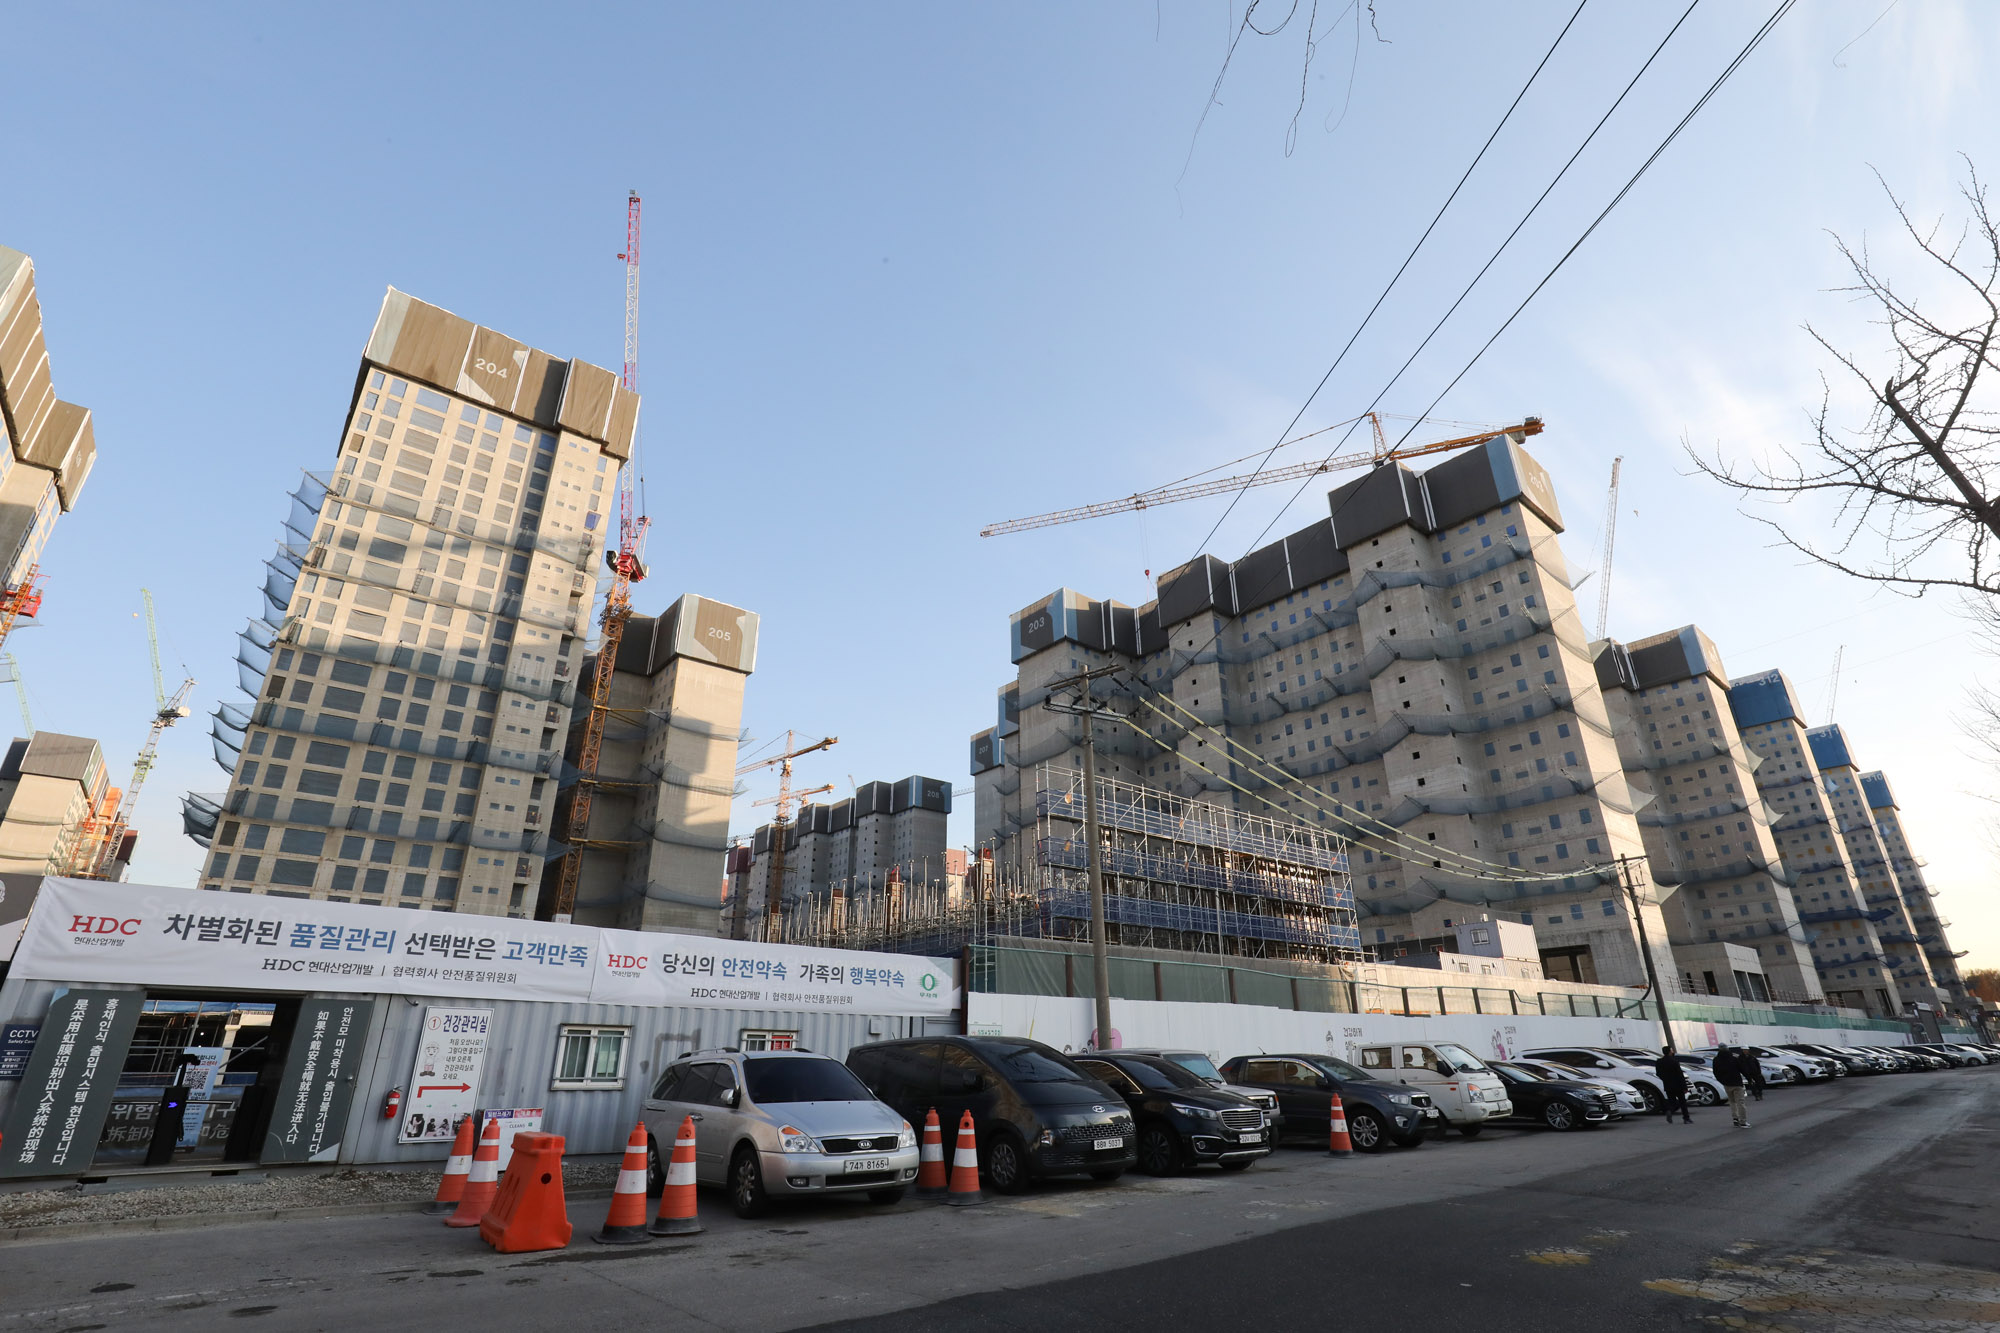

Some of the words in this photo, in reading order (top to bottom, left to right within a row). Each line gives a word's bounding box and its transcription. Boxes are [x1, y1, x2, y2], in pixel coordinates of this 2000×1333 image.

[475, 358, 507, 378] 204
[708, 627, 731, 641] 205
[1028, 616, 1045, 634] 203
[1759, 673, 1780, 686] 312
[68, 915, 142, 935] HDC
[74, 936, 125, 947] 현대산업개발
[163, 914, 283, 946] 차별화된
[290, 923, 396, 954] 품질관리
[405, 932, 497, 961] 선택받은
[502, 941, 589, 968] 고객만족
[261, 958, 305, 972] HDC
[308, 961, 374, 976] 현대산업개발
[393, 965, 438, 980] 협력회사
[442, 968, 517, 984] 안전품질위원회
[607, 954, 648, 970] HDC
[662, 953, 715, 976] 당신의
[721, 957, 788, 981] 안전약속
[800, 964, 844, 985] 가족의
[850, 967, 905, 988] 행복약속
[612, 970, 641, 979] 현대산업개발
[690, 988, 718, 998] HDC
[719, 989, 761, 1000] 현대산업개발
[772, 992, 801, 1003] 협력회사
[804, 994, 853, 1005] 안전품질위원회
[95, 998, 119, 1043] 홍채인식
[338, 1007, 354, 1036] 안전모
[443, 1015, 488, 1033] 건강관리실
[9, 1029, 39, 1038] CCTV
[327, 1038, 346, 1079] 미착용시
[74, 1045, 104, 1103] 출입시스템
[309, 1081, 336, 1154] 출입불가입니다
[52, 1105, 83, 1166] 현장입니다
[866, 1160, 885, 1169] 8165
